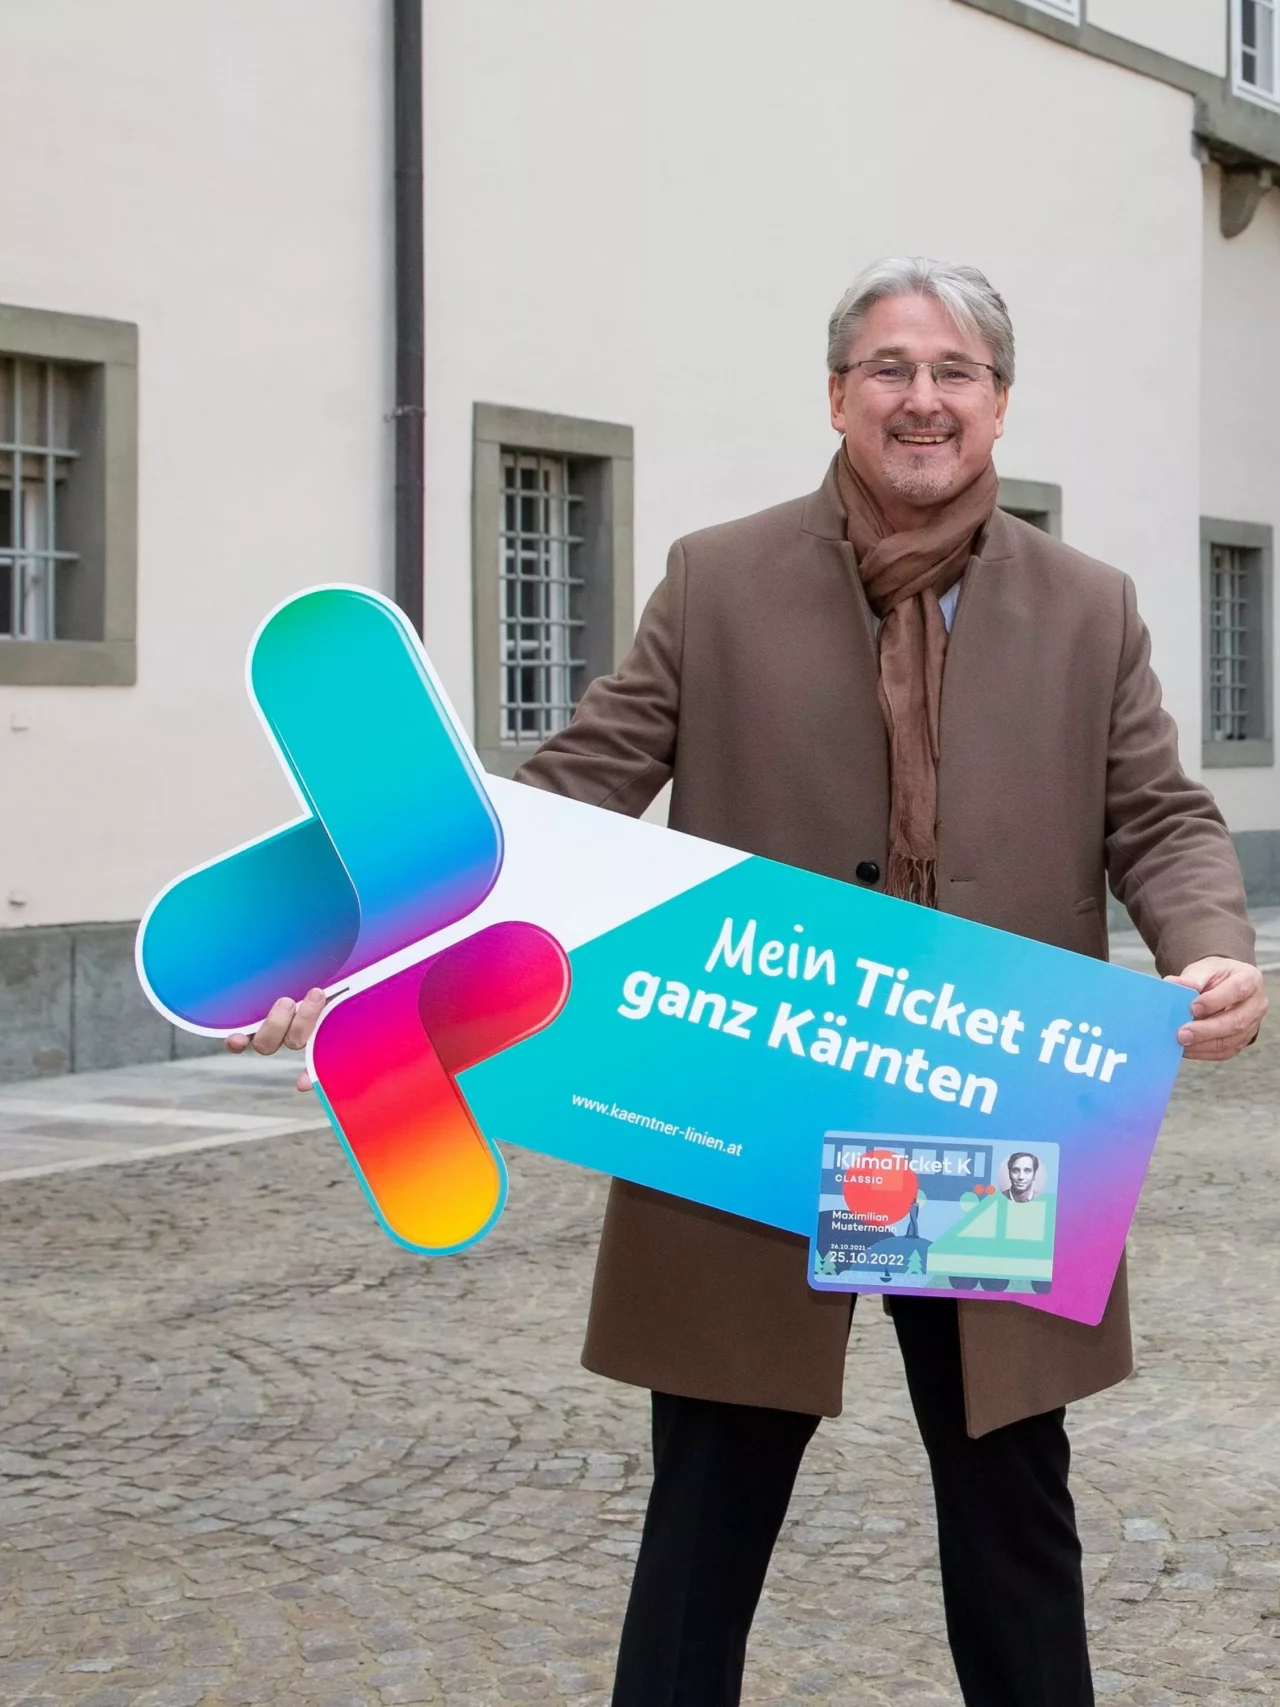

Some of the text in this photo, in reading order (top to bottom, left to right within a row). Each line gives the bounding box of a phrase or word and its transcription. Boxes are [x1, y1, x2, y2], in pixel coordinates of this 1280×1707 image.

[705, 917, 1127, 1083] Mein Ticket für
[617, 970, 998, 1114] ganz Kärnten
[572, 1094, 743, 1156] www.kaerntner-linien.at
[836, 1152, 972, 1174] KlimaTicket K
[835, 1174, 883, 1185] CLASSIC
[832, 1211, 889, 1222] Maximilian
[831, 1222, 897, 1233] Mustermann
[829, 1251, 904, 1266] 25.10.2022
